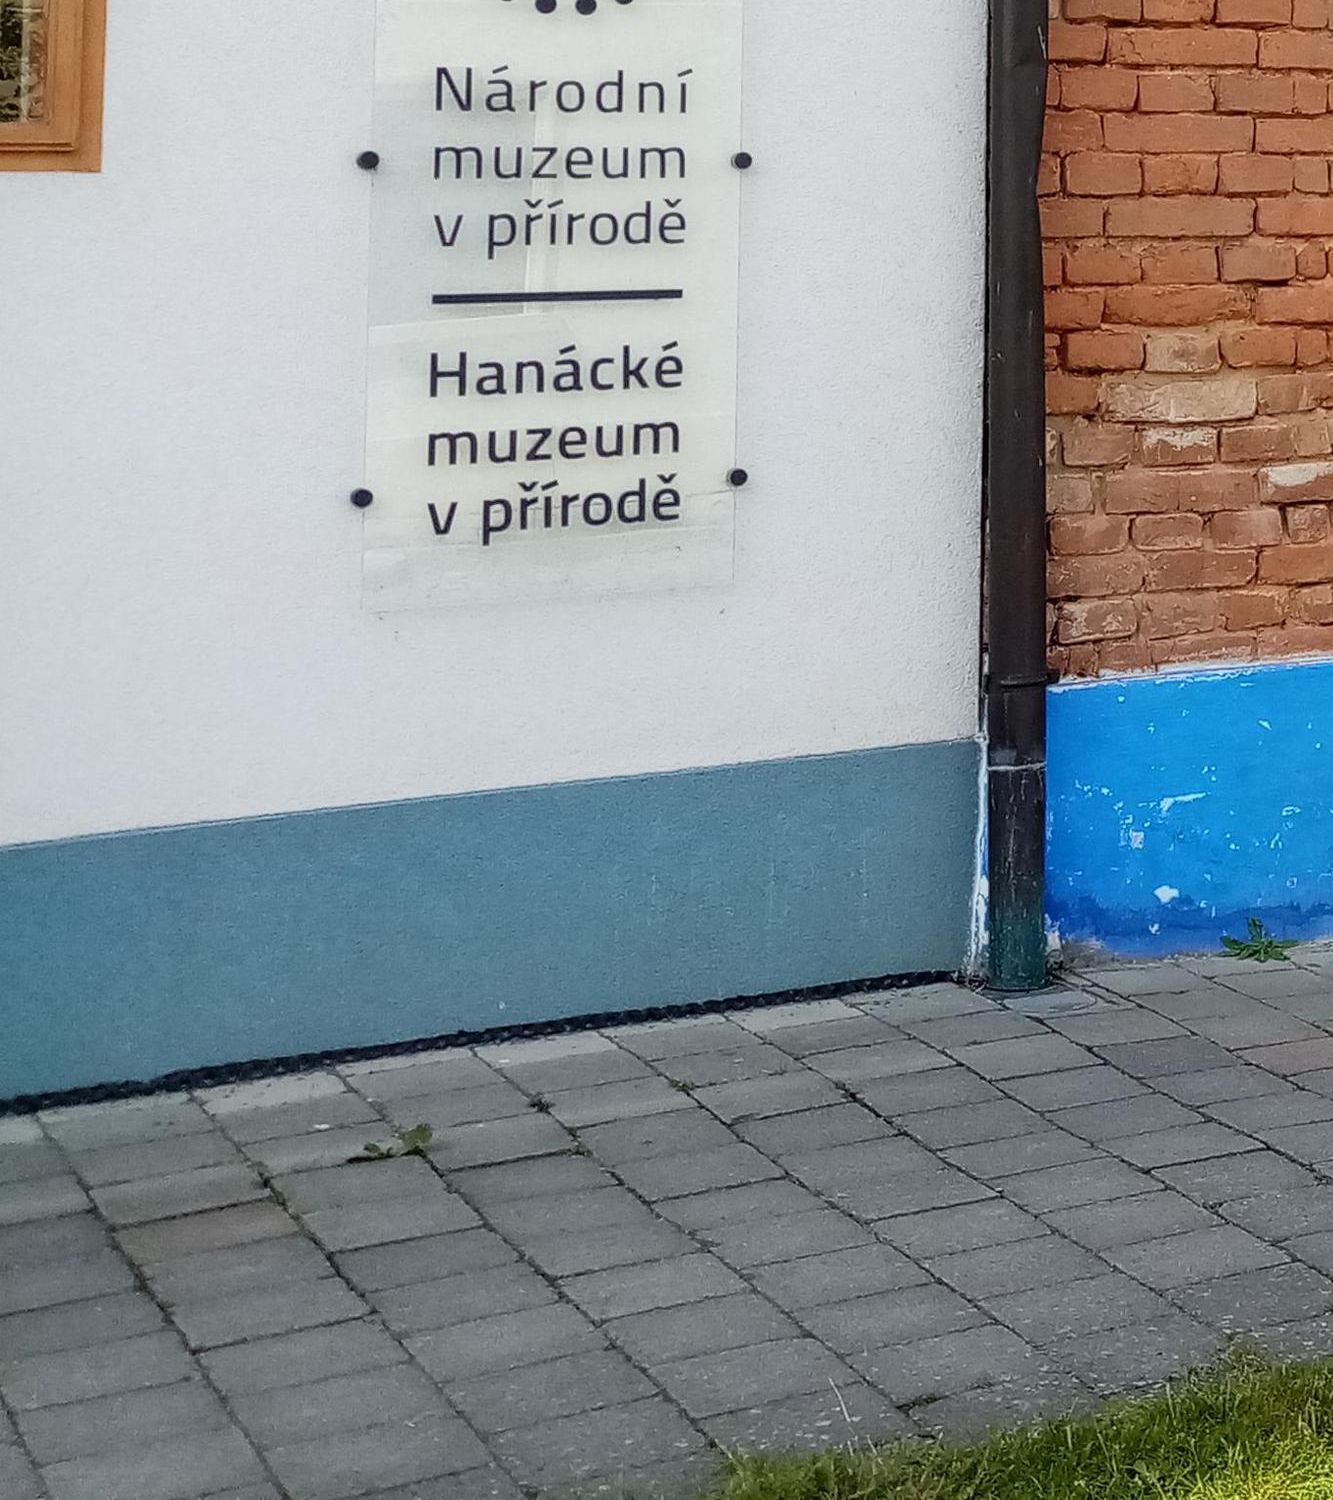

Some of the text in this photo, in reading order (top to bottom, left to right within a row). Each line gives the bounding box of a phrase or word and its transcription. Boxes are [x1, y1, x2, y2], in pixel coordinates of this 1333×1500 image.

[434, 65, 692, 114] Národní
[433, 146, 687, 180] muzeum
[433, 198, 687, 261] v přírodě
[428, 340, 684, 399] Hanácké
[427, 421, 681, 467] muzeum
[427, 472, 682, 547] v přírodě
